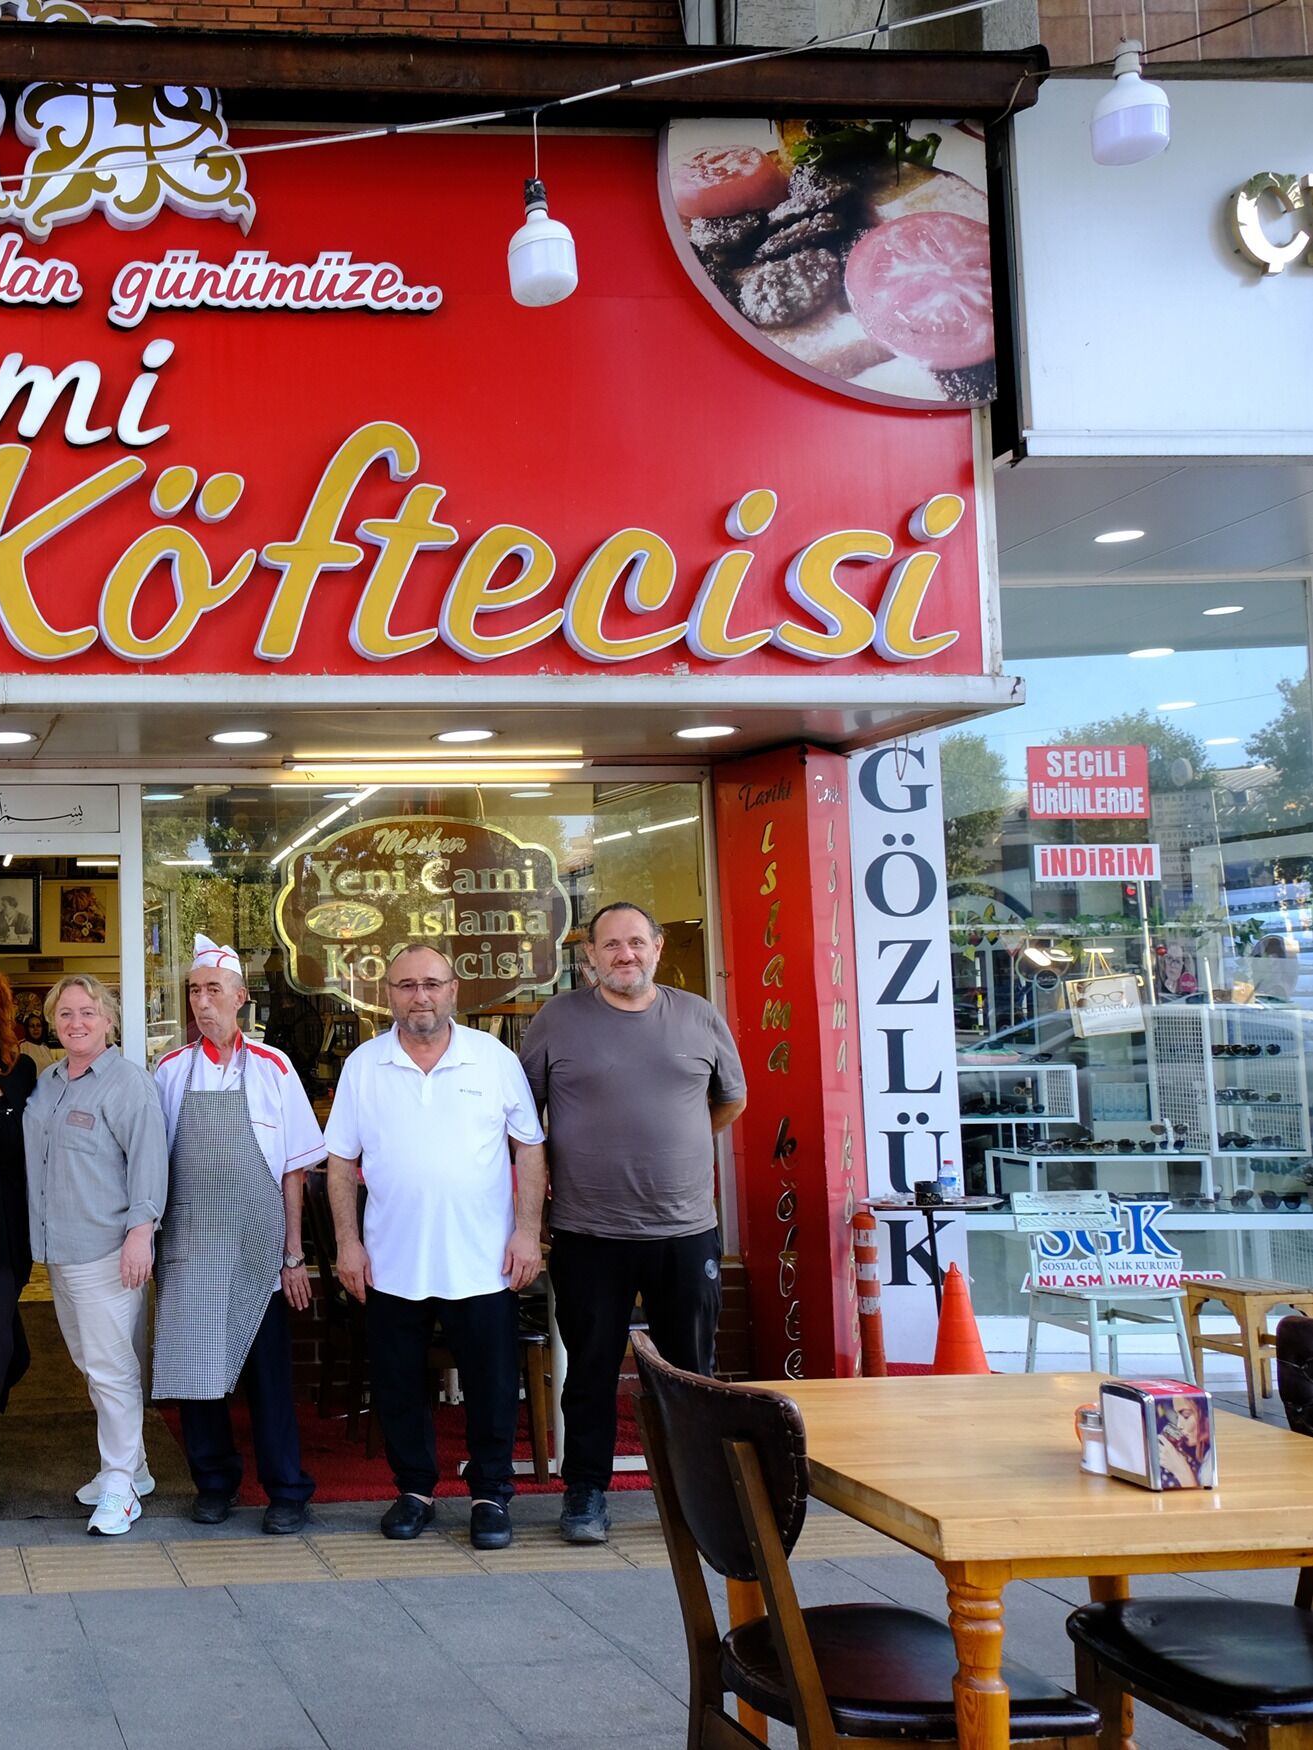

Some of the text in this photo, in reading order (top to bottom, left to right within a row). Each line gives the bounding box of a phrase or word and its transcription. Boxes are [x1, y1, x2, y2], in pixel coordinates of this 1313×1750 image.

[1046, 750, 1126, 780] SEÇİLİ
[1032, 783, 1145, 814] ÜRÜNLERDE
[312, 857, 538, 897] Yeni Cami
[1040, 847, 1154, 877] İNDİRİM
[322, 942, 537, 983] Köcisi
[859, 746, 956, 1287] GÖZLÜK
[1042, 1260, 1181, 1272] SOSYAL GÜVNLİK KURUMU
